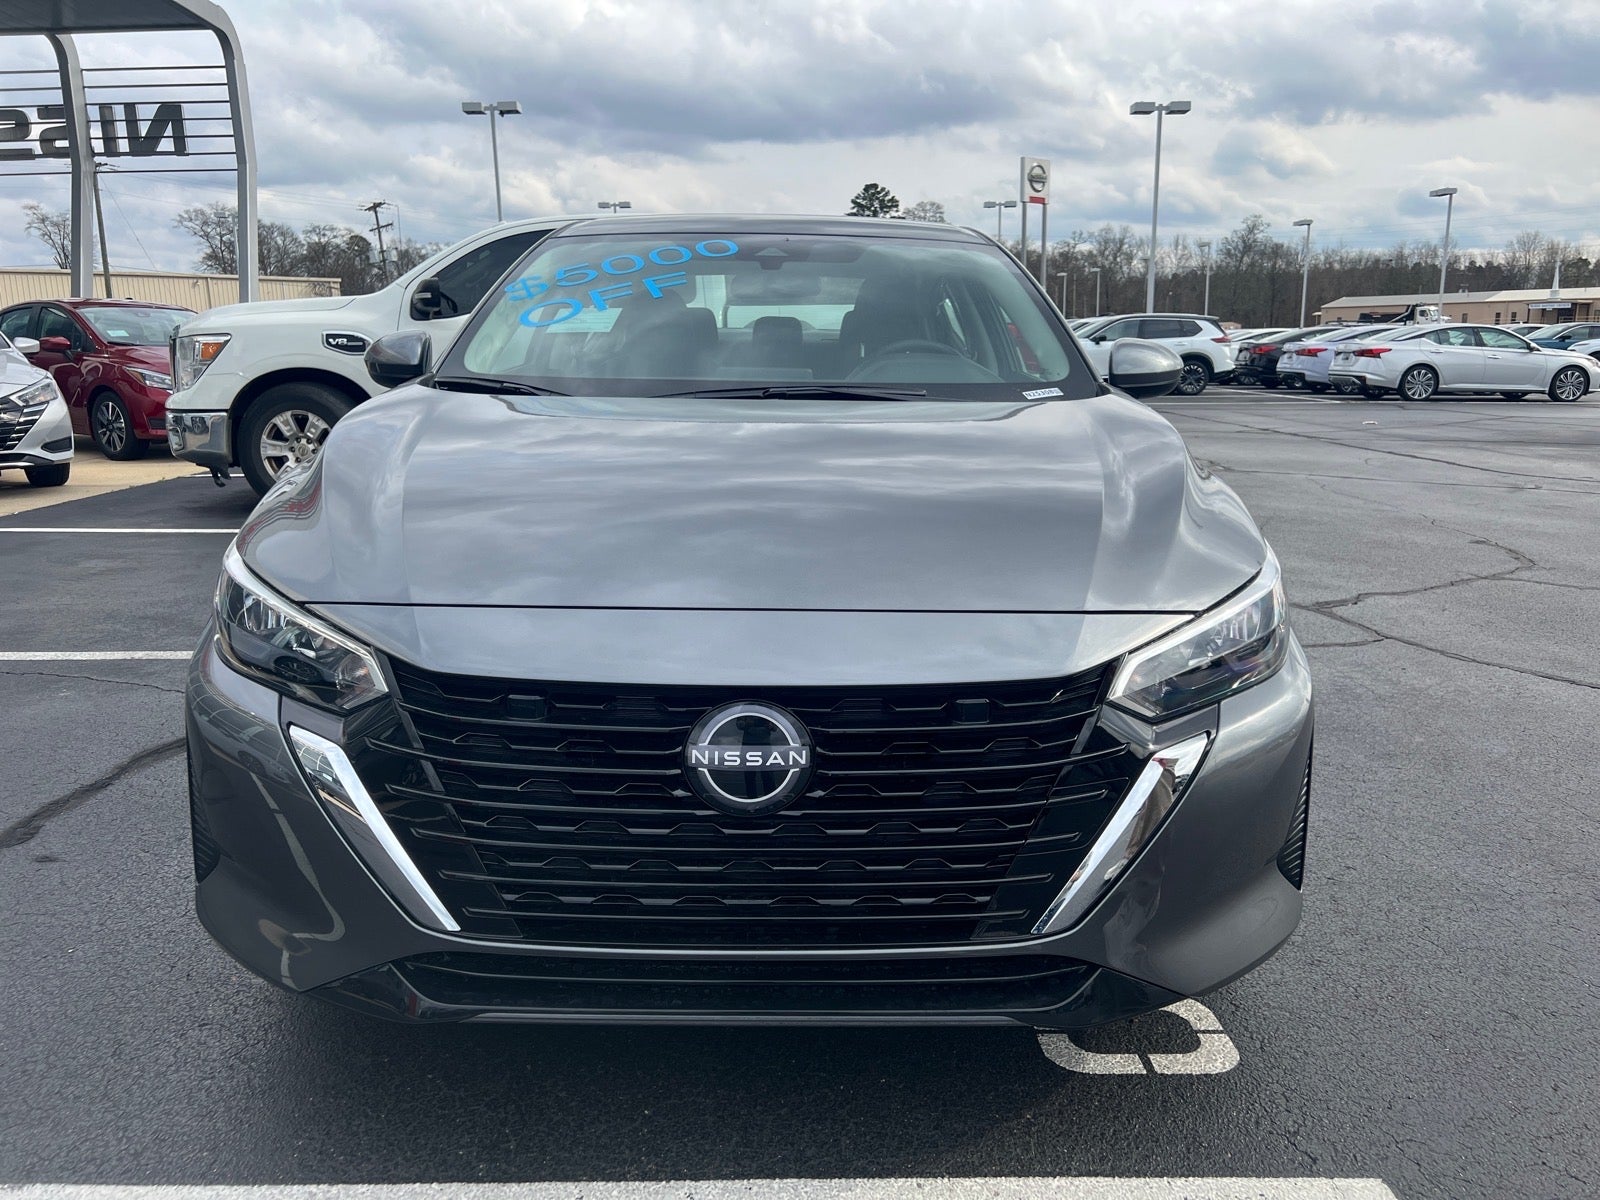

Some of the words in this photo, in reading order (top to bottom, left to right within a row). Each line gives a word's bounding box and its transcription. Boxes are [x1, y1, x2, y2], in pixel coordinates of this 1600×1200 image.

[504, 239, 739, 301] $5000
[518, 271, 688, 328] OFF
[691, 749, 807, 766] NISSAN
